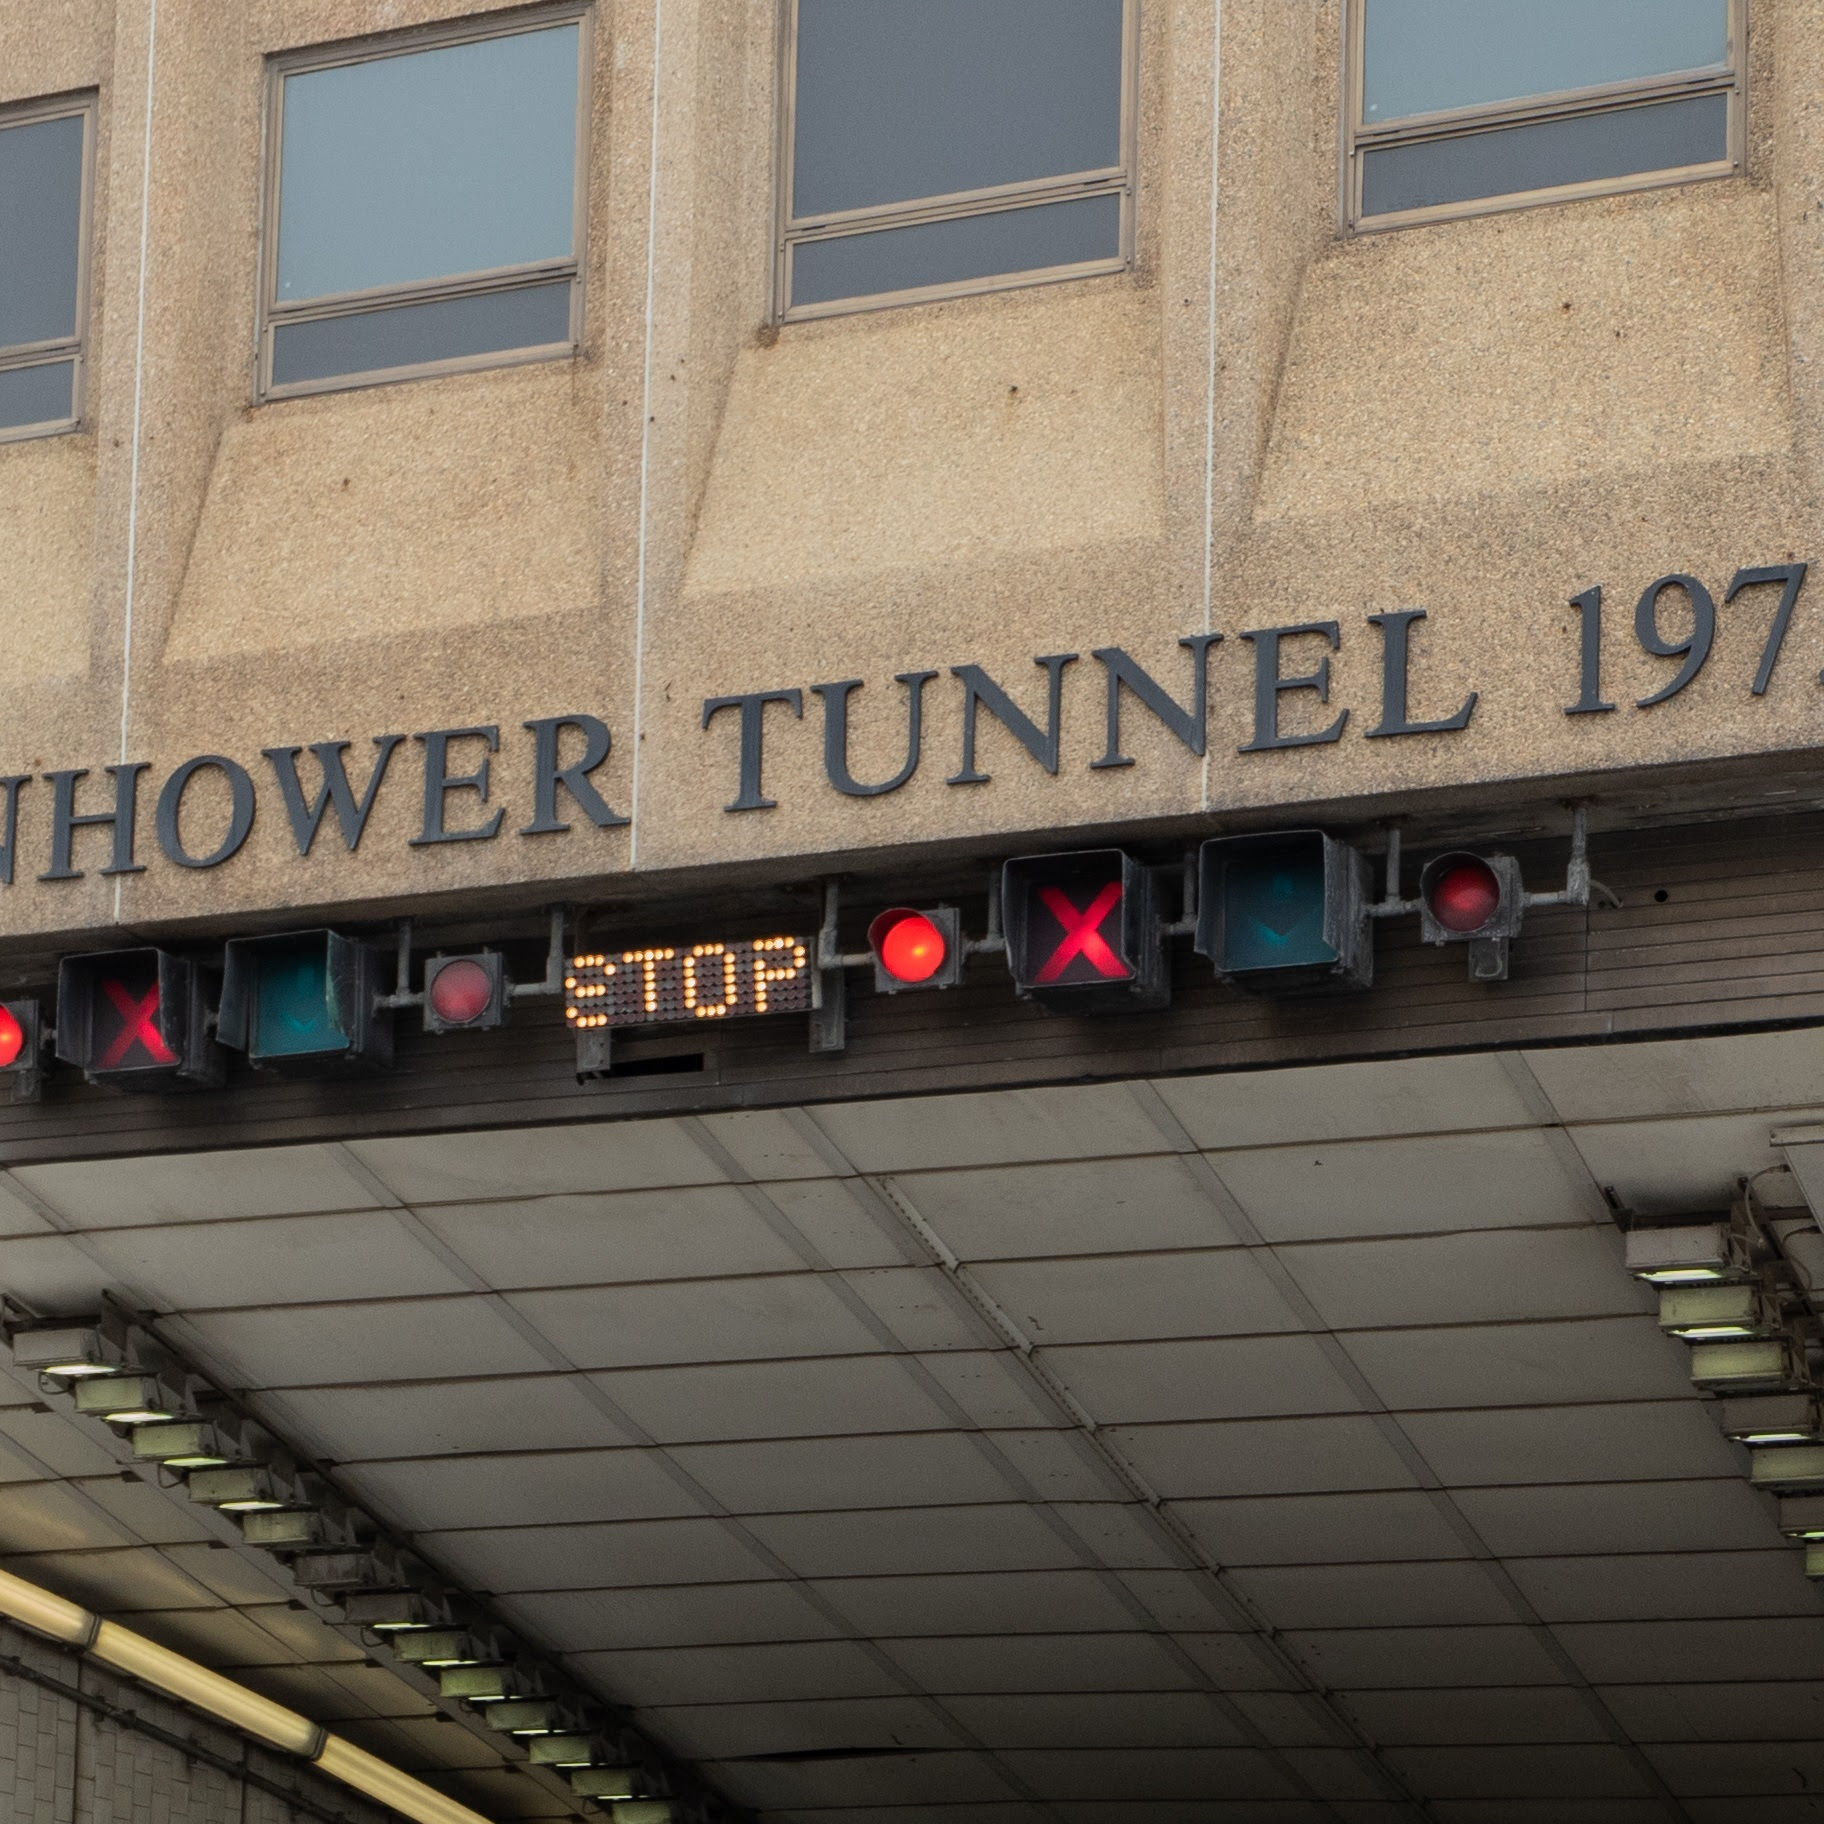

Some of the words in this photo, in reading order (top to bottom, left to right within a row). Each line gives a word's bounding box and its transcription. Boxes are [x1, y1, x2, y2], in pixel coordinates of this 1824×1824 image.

[700, 608, 1478, 813] TUNNEL
[1562, 562, 1824, 715] 197
[564, 936, 807, 1029] STOP
